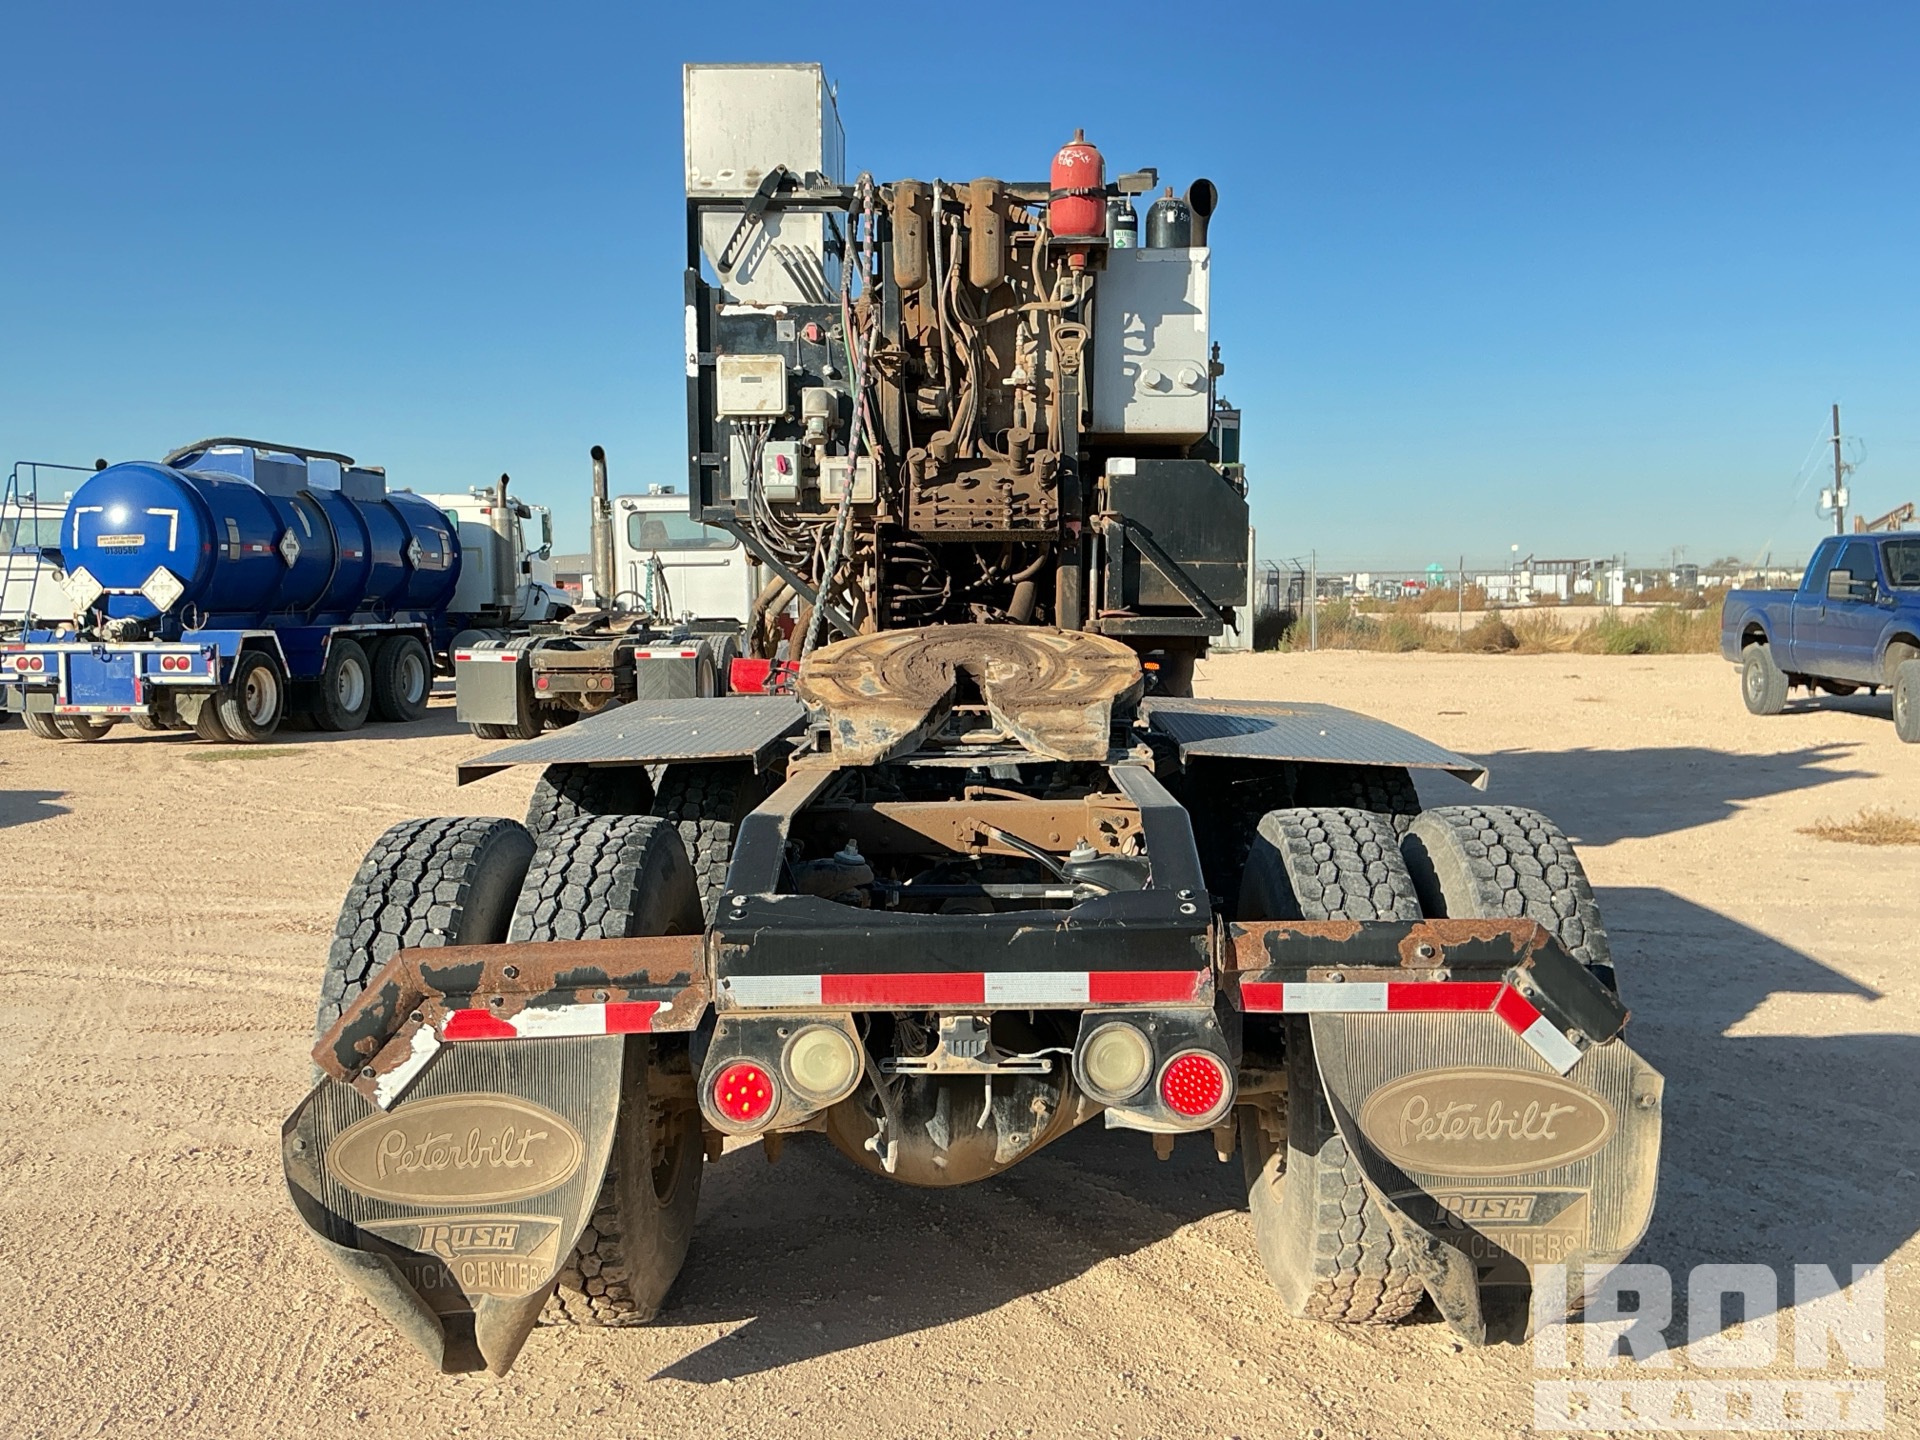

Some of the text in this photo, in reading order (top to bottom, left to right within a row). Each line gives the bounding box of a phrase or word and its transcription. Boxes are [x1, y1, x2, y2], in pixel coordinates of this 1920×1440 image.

[1400, 1094, 1577, 1147] Peterbilt
[376, 1127, 549, 1181] Peterbilt
[418, 1225, 518, 1258] RUSH
